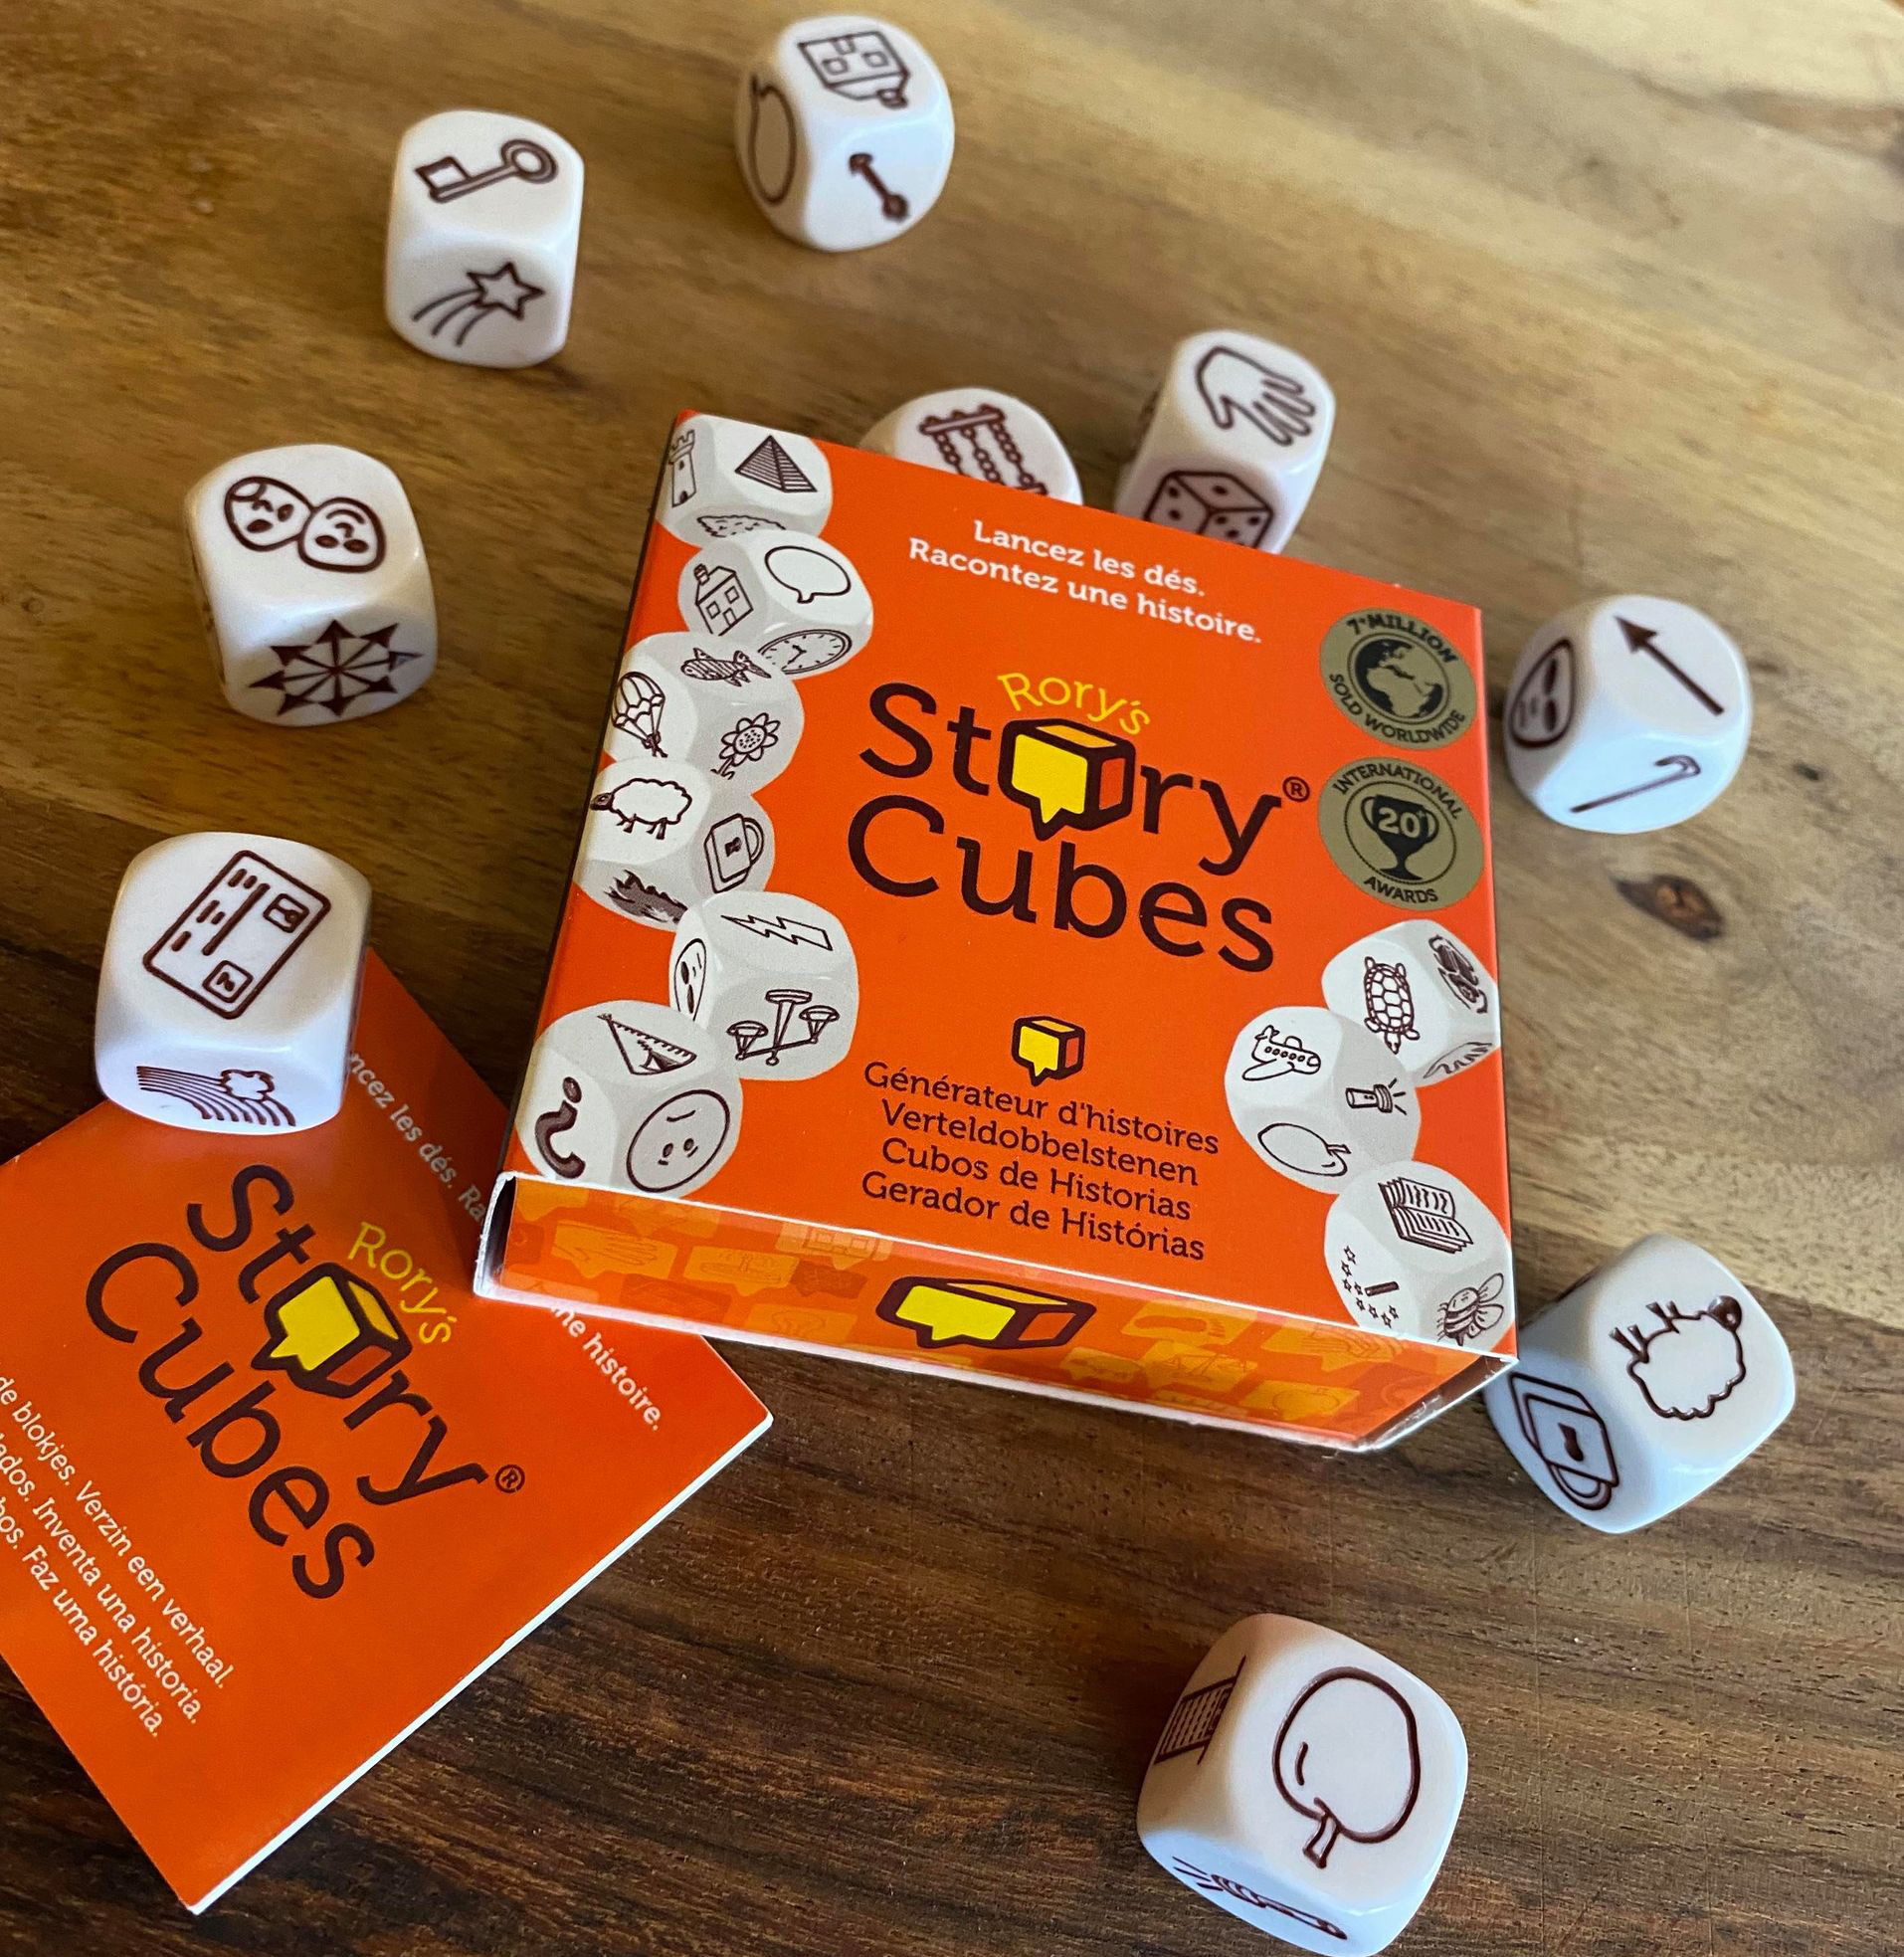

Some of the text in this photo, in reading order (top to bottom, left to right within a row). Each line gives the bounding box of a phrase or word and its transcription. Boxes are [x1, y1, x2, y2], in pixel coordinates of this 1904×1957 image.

[908, 538, 1261, 643] Racontez une histoire.
[974, 520, 1206, 597] Lancez les dés.
[997, 672, 1150, 735] Rory's
[1329, 674, 1465, 744] SOLD WORLDWIDE
[1332, 762, 1463, 820] INTERNATIONAL
[848, 794, 1273, 972] Cubes
[1364, 876, 1438, 903] AWARDS
[350, 1053, 457, 1189] ncez les dés.
[864, 1061, 1219, 1155] Générateur d'histoires
[881, 1098, 1199, 1186] Verteldobbelstenen
[861, 1170, 1205, 1261] Gerador de Histórias
[882, 1137, 1191, 1221] Cubos de Historias
[346, 1221, 459, 1344] Rory's
[551, 1306, 663, 1431] ne histoire.
[85, 1242, 376, 1600] Cubes
[12, 1401, 76, 1485] blokjes.
[76, 1479, 133, 1557] Verzin
[127, 1555, 166, 1602] een
[162, 1598, 235, 1688] verhaal.
[22, 1544, 60, 1592] Faz
[53, 1589, 98, 1646] uma
[93, 1639, 163, 1738] história.
[32, 1497, 101, 1587] Inventa
[96, 1583, 136, 1634] una
[131, 1627, 202, 1724] historia.
